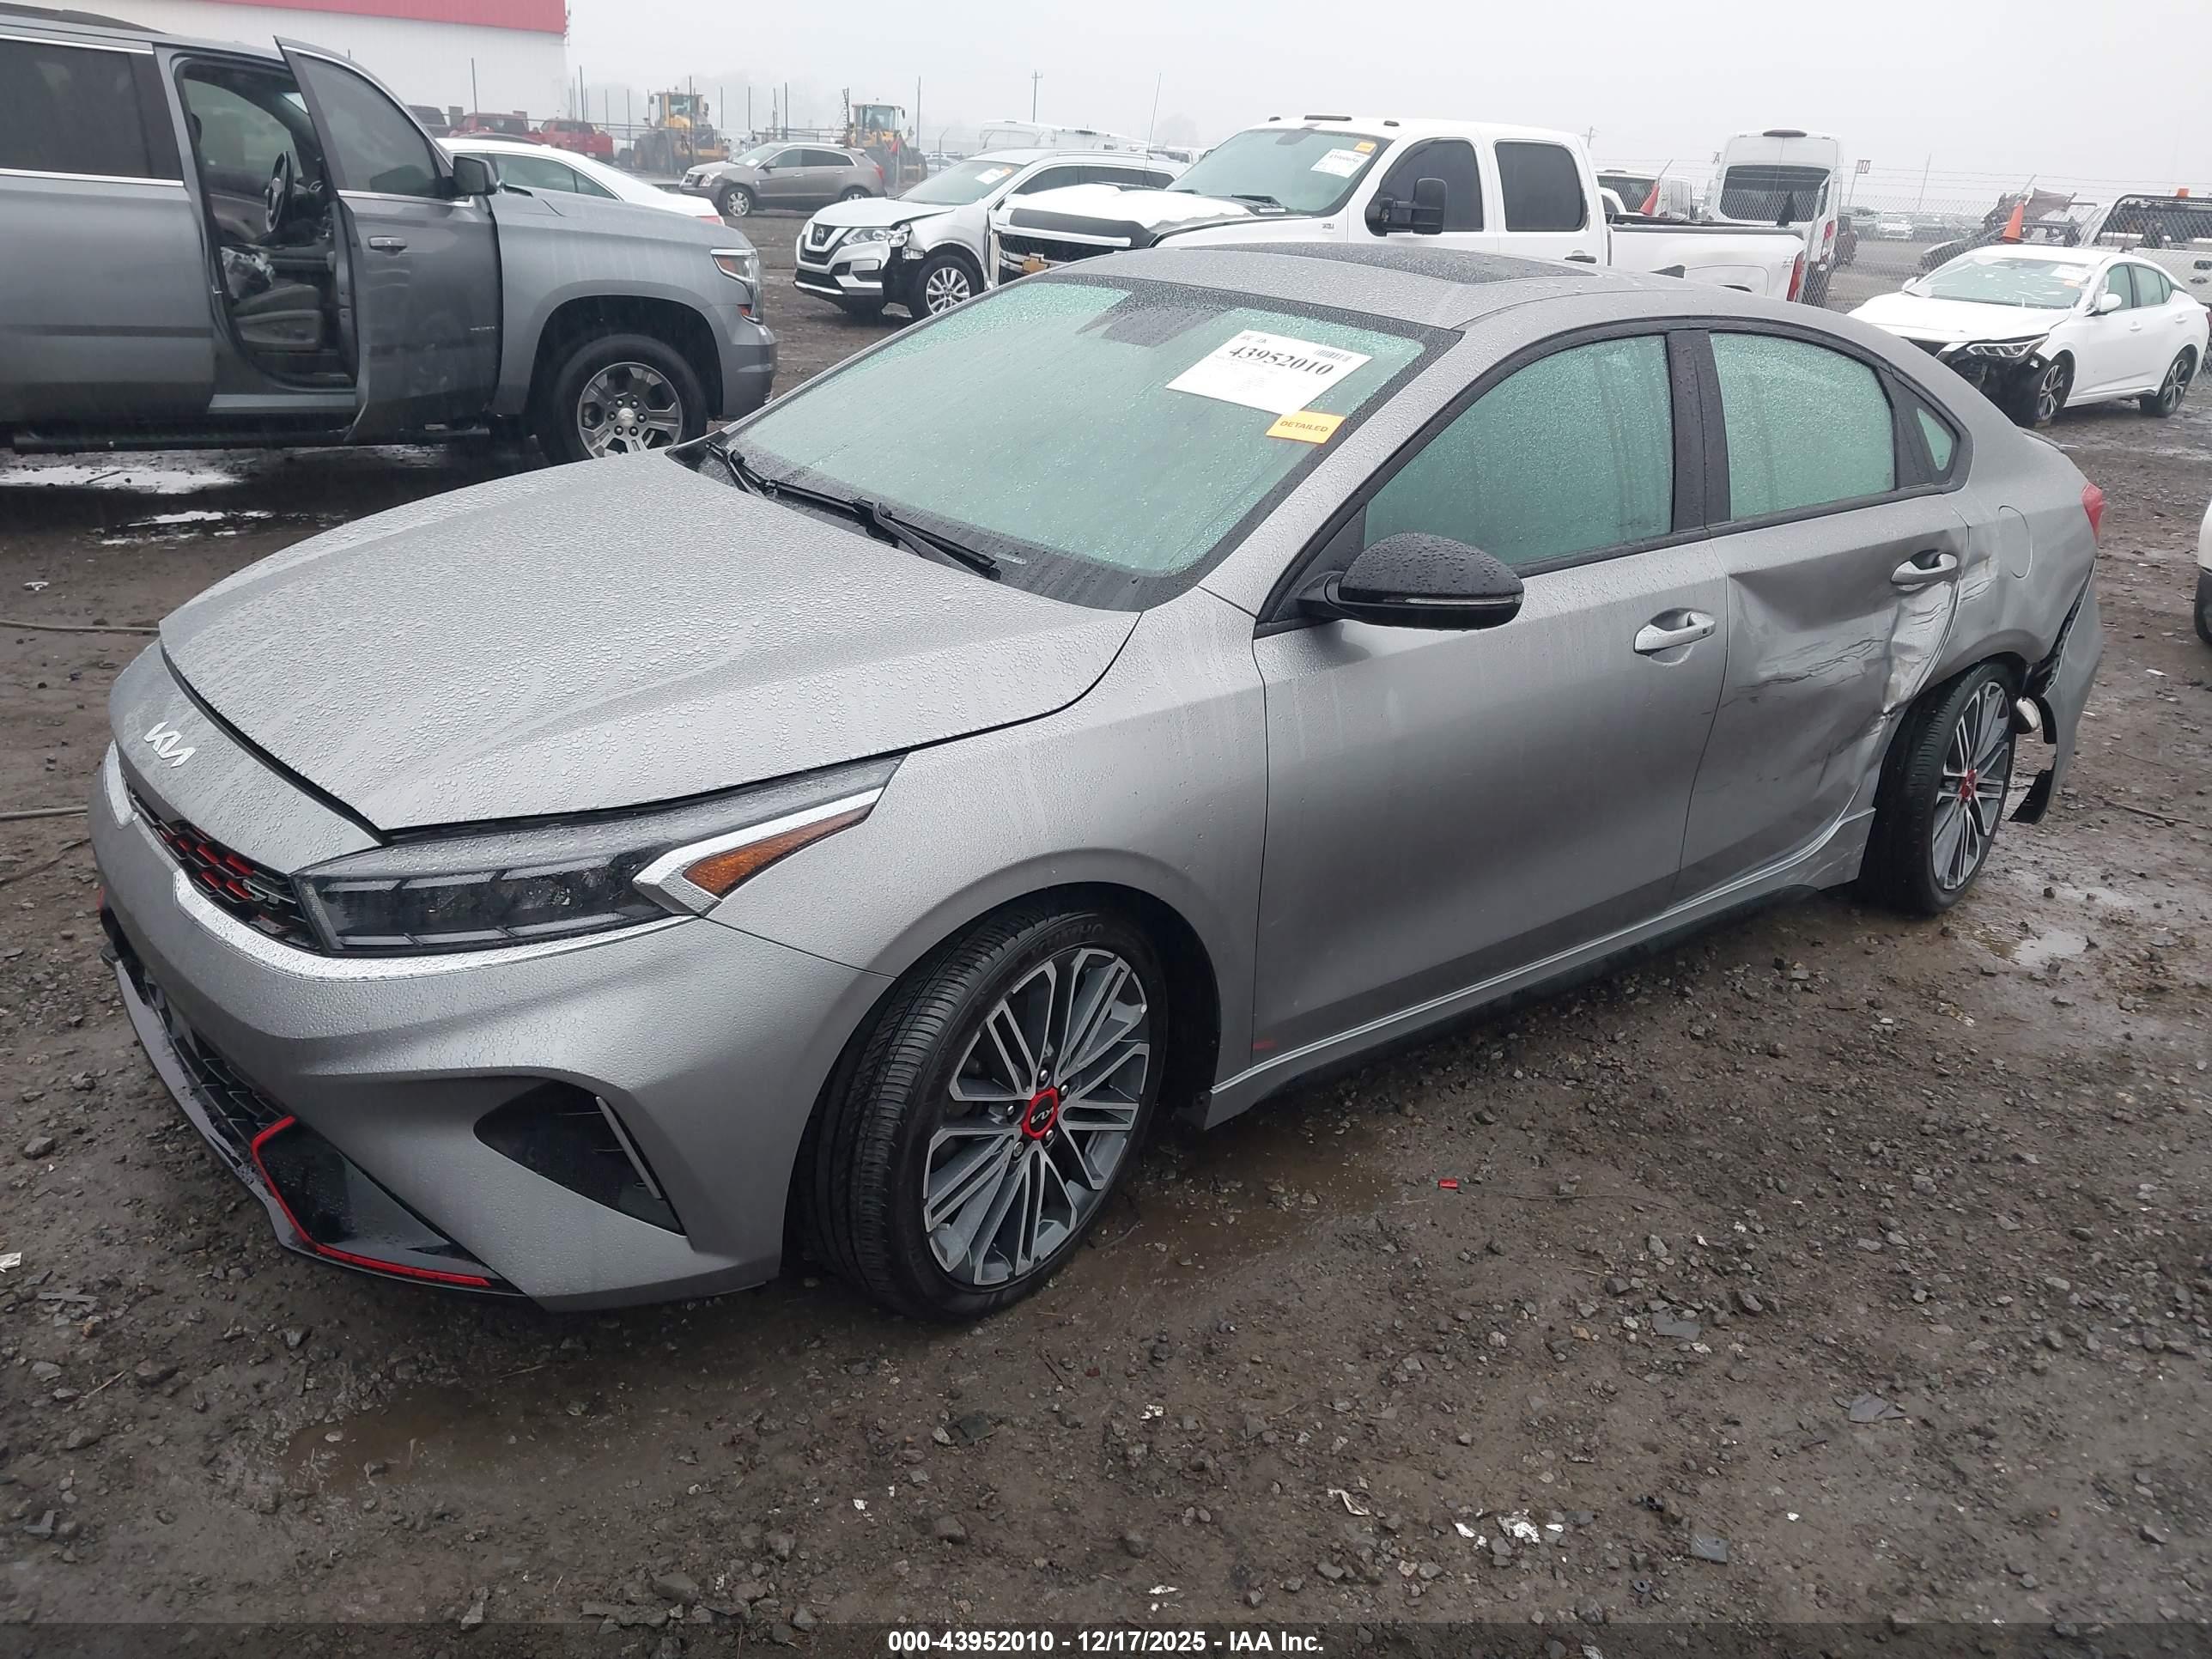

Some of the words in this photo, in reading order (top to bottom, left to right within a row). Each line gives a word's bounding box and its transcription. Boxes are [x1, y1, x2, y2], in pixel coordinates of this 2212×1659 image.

[1229, 345, 1334, 375] 43952010
[1279, 420, 1329, 433] DETAILED
[143, 721, 196, 769] KIA
